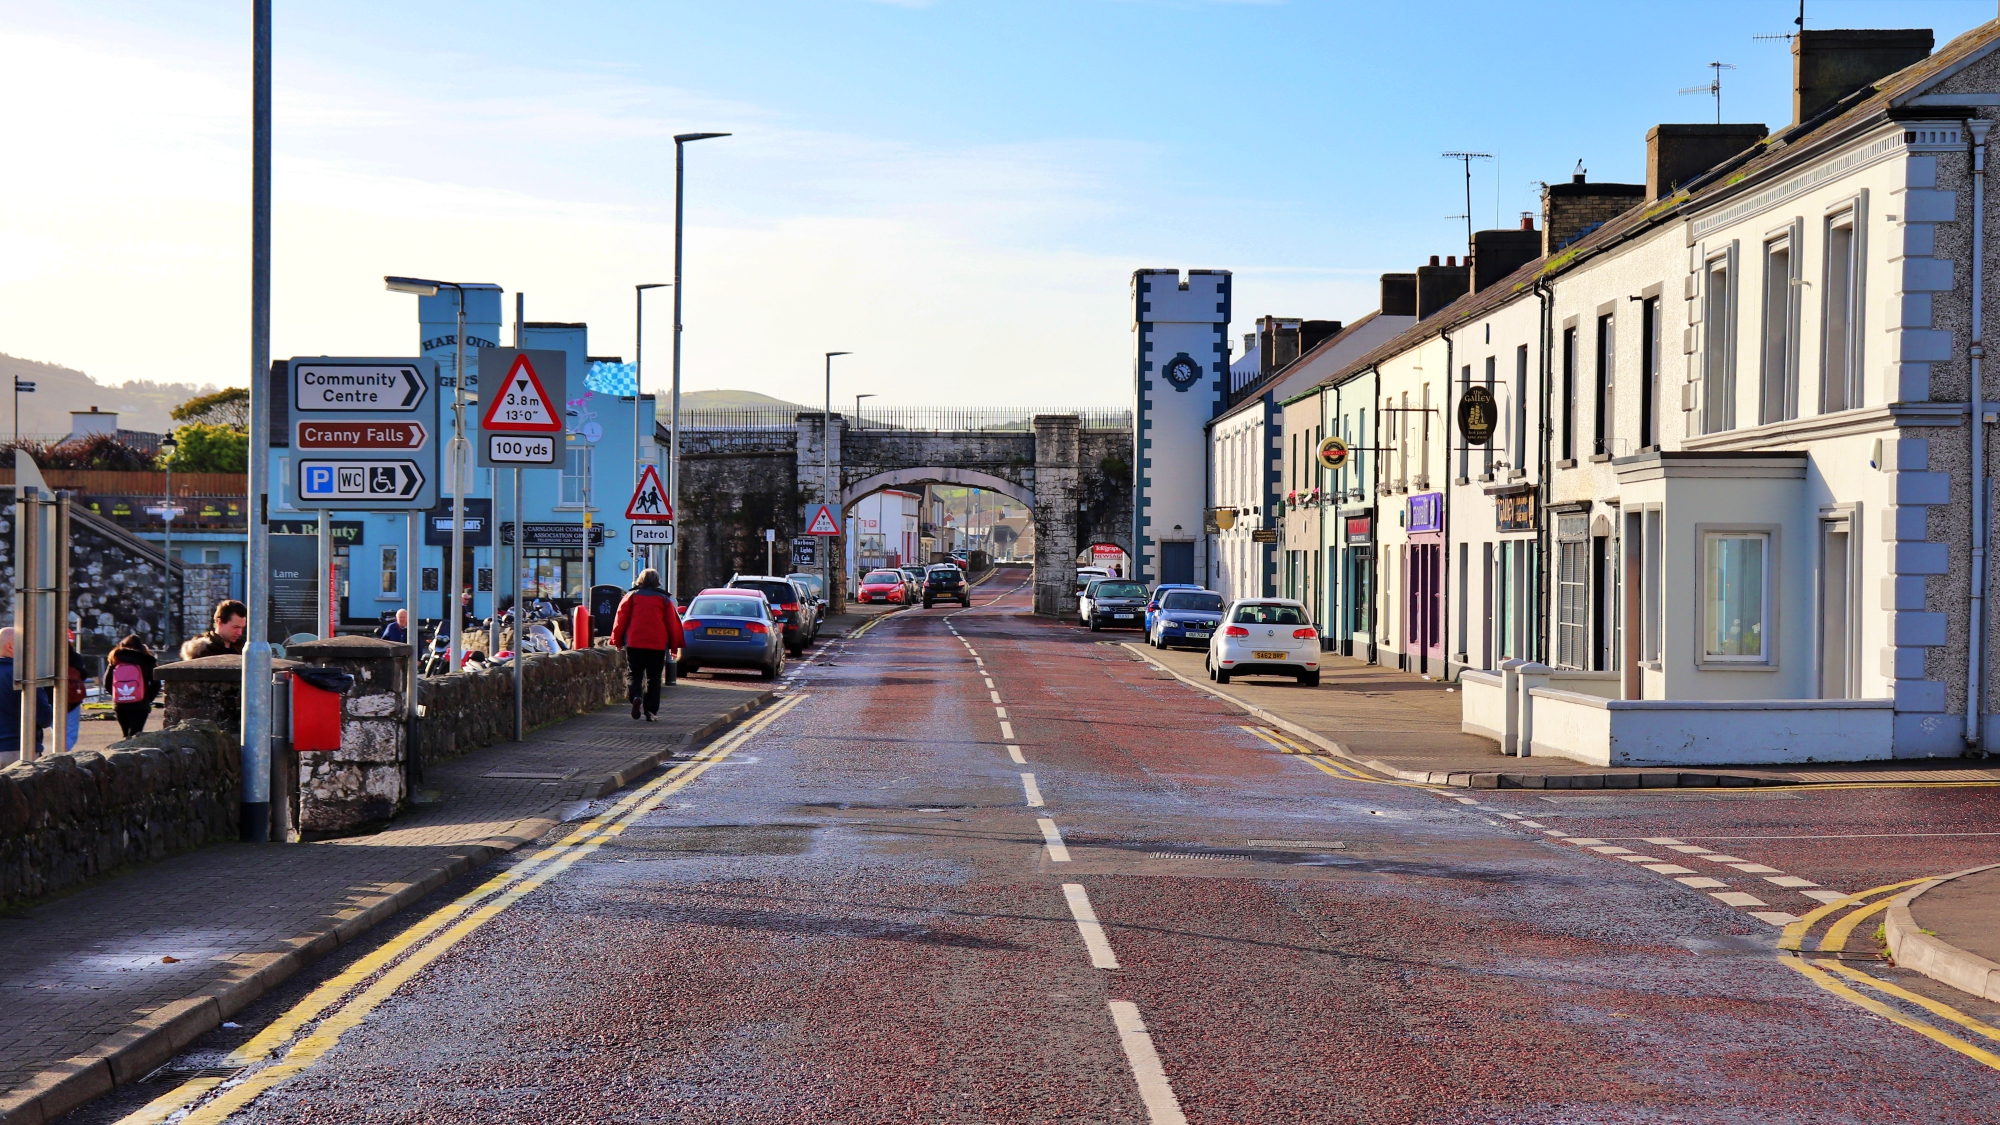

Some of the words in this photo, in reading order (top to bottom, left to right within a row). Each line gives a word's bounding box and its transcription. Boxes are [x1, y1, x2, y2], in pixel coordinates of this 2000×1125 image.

[422, 334, 496, 351] HAROUR
[304, 372, 397, 388] Community
[323, 389, 378, 402] Centre
[305, 427, 360, 444] Cranny
[367, 428, 404, 441] Falls
[496, 442, 522, 454] 100
[525, 443, 548, 457] yds
[313, 469, 330, 491] P
[341, 473, 361, 487] WC
[301, 524, 358, 540] Buty
[636, 530, 668, 539] Patrol
[274, 569, 299, 578] Larne
